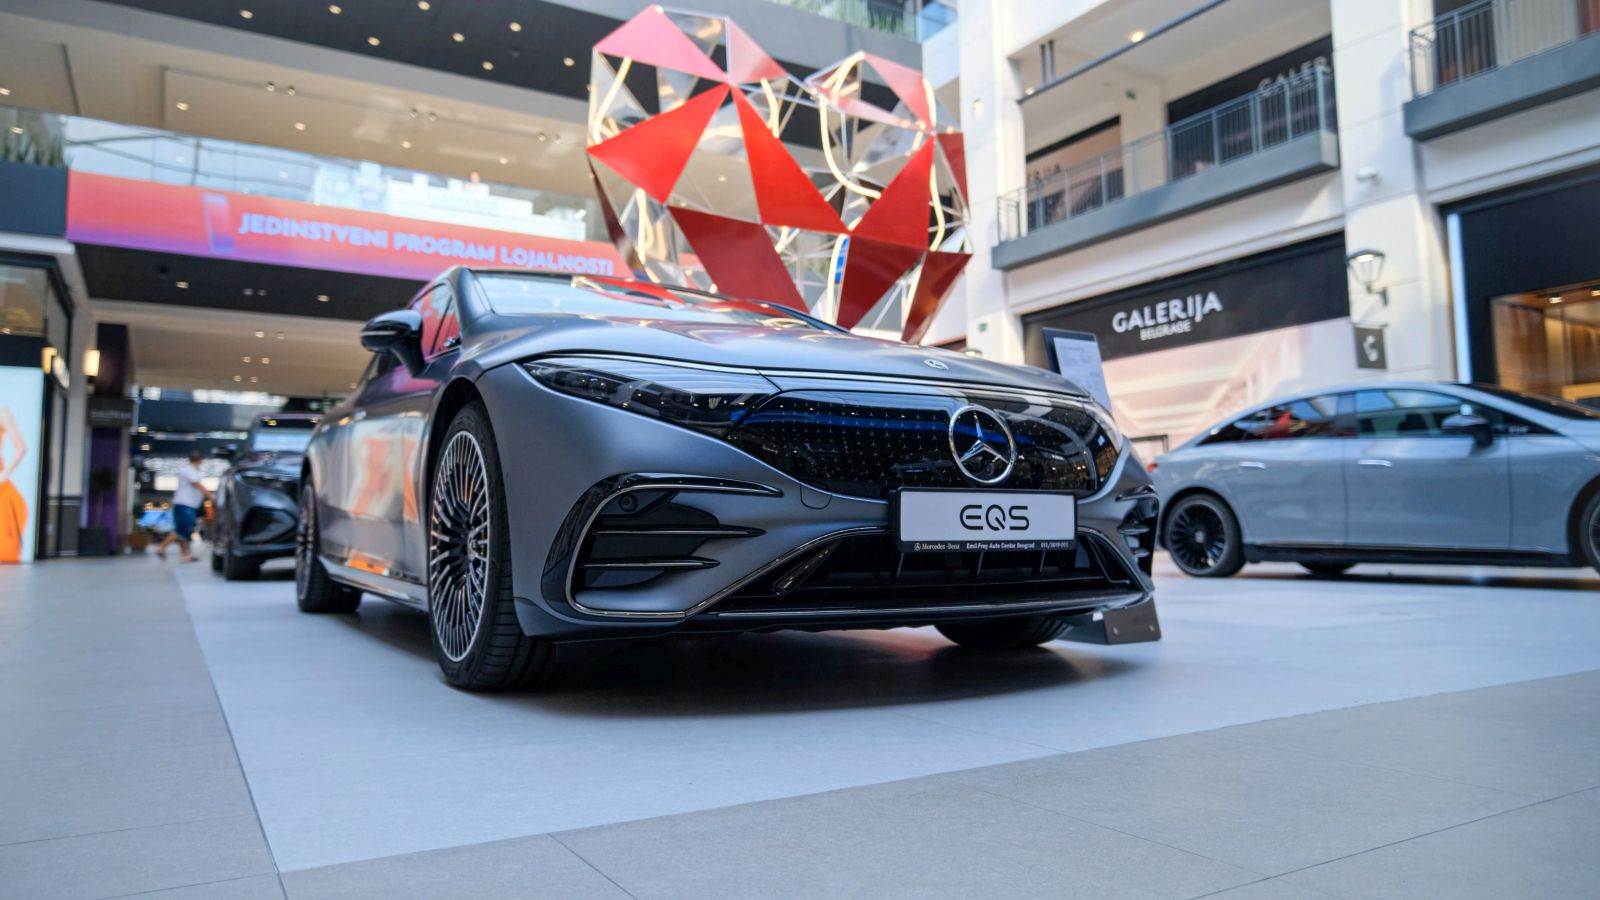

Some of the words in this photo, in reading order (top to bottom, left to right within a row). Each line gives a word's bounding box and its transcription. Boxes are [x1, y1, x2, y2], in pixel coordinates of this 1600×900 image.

[238, 212, 388, 248] JEDINSTVENI
[393, 231, 496, 262] PROGRAM
[500, 247, 613, 276] LOJALNOSTI
[1112, 291, 1223, 333] GALERIJA
[1140, 320, 1191, 341] BELGRADE
[959, 504, 1030, 532] EQS
[978, 542, 988, 551] Frey
[1017, 541, 1035, 550] Beograd
